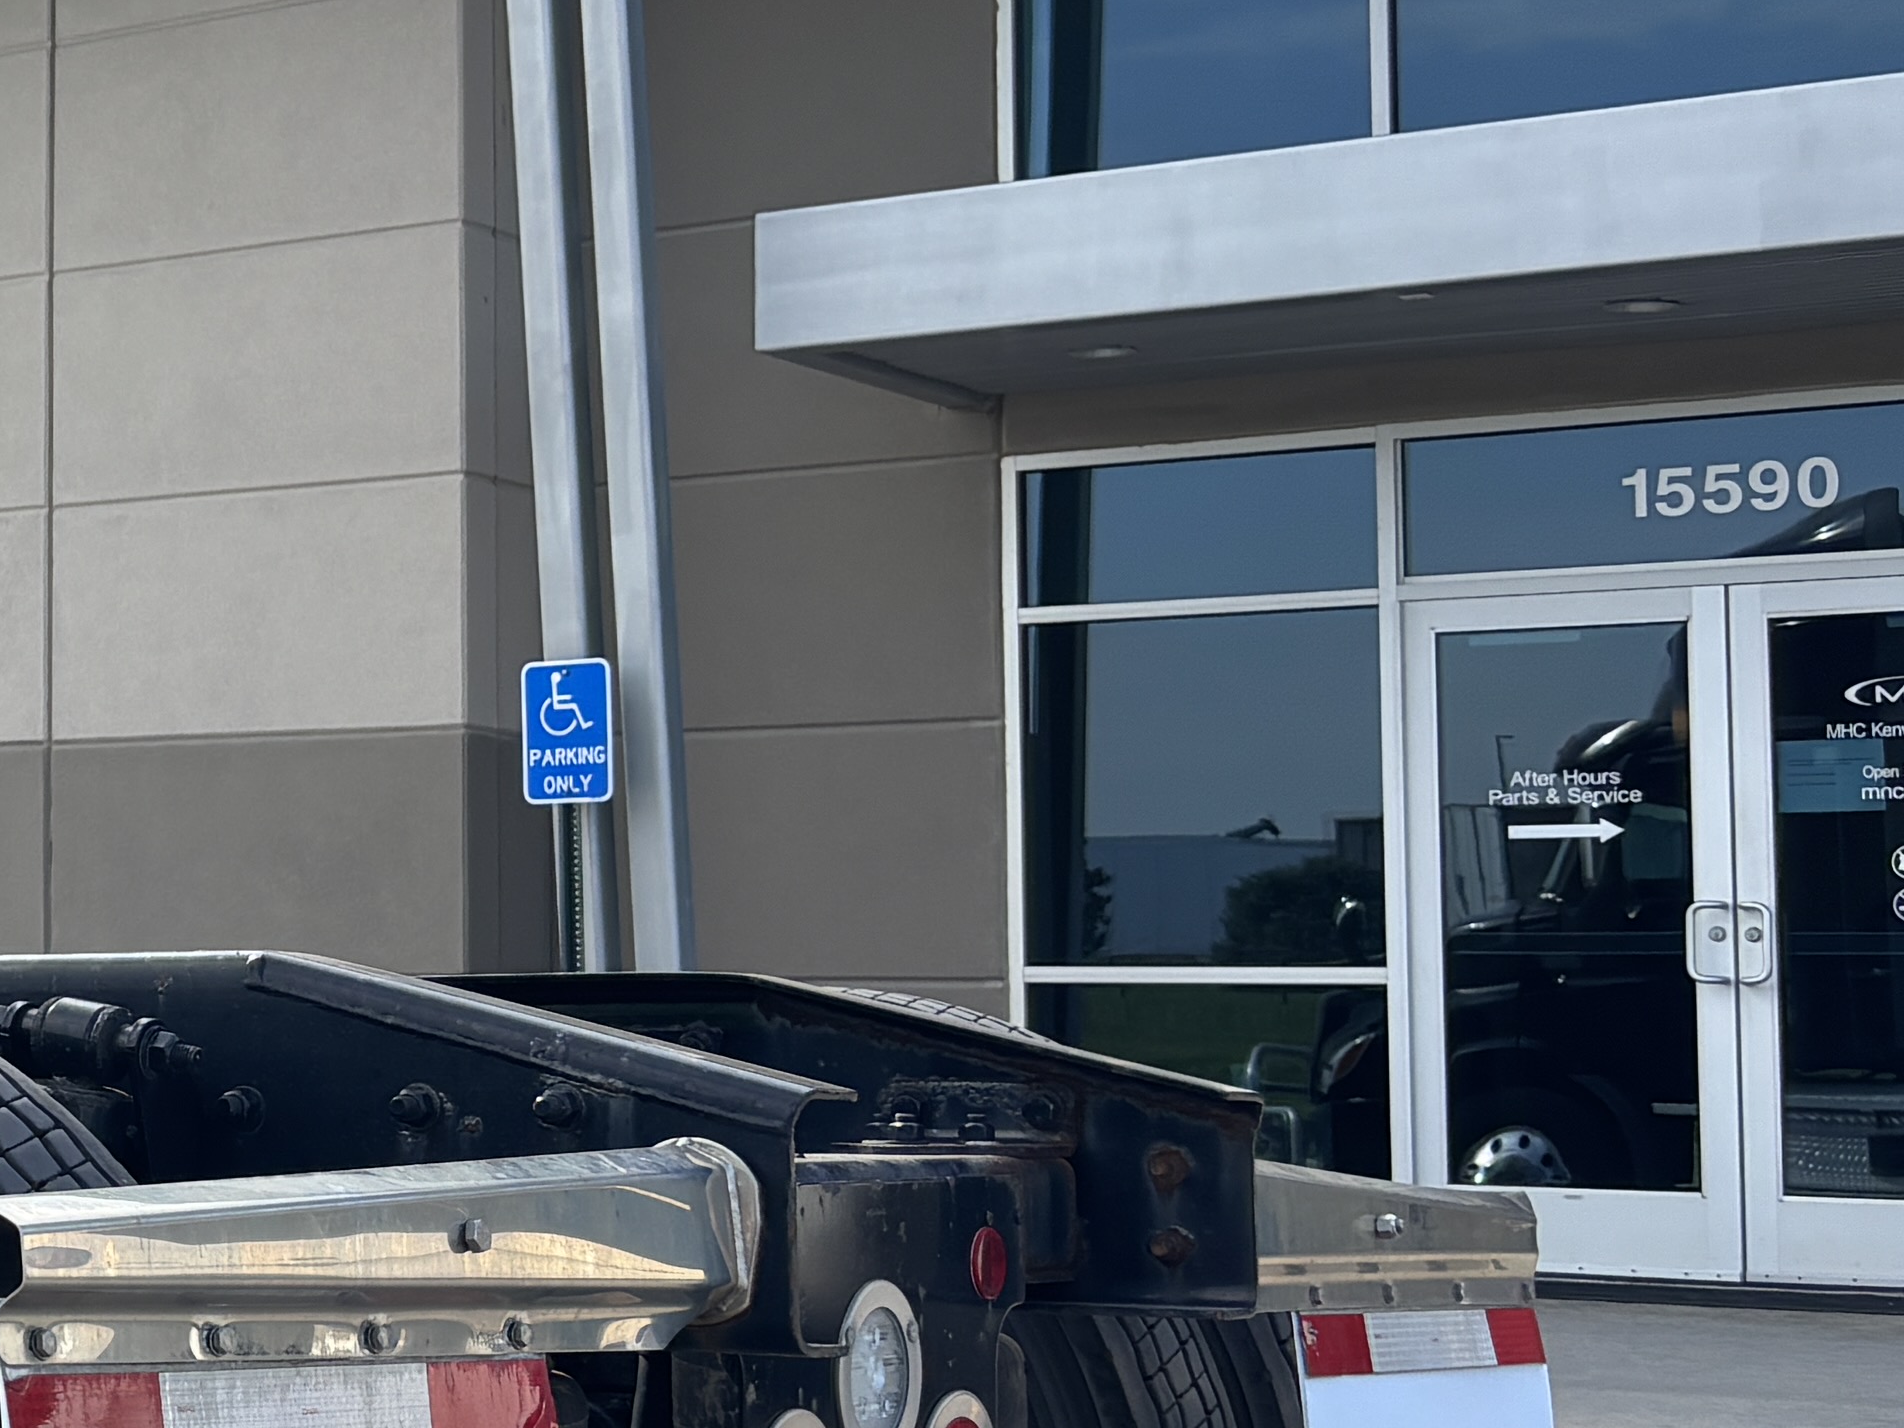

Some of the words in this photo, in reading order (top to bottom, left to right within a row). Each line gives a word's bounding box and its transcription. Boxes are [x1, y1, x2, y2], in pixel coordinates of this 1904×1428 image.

[1622, 456, 1840, 518] 15590
[1826, 723, 1867, 739] MHC
[529, 746, 606, 767] PARKING
[1510, 770, 1558, 787] After
[1563, 769, 1622, 786] Hours
[1862, 765, 1900, 782] Open
[543, 774, 593, 794] ONLY
[1488, 789, 1540, 806] Parts
[1545, 787, 1561, 804] &
[1567, 787, 1643, 804] Service
